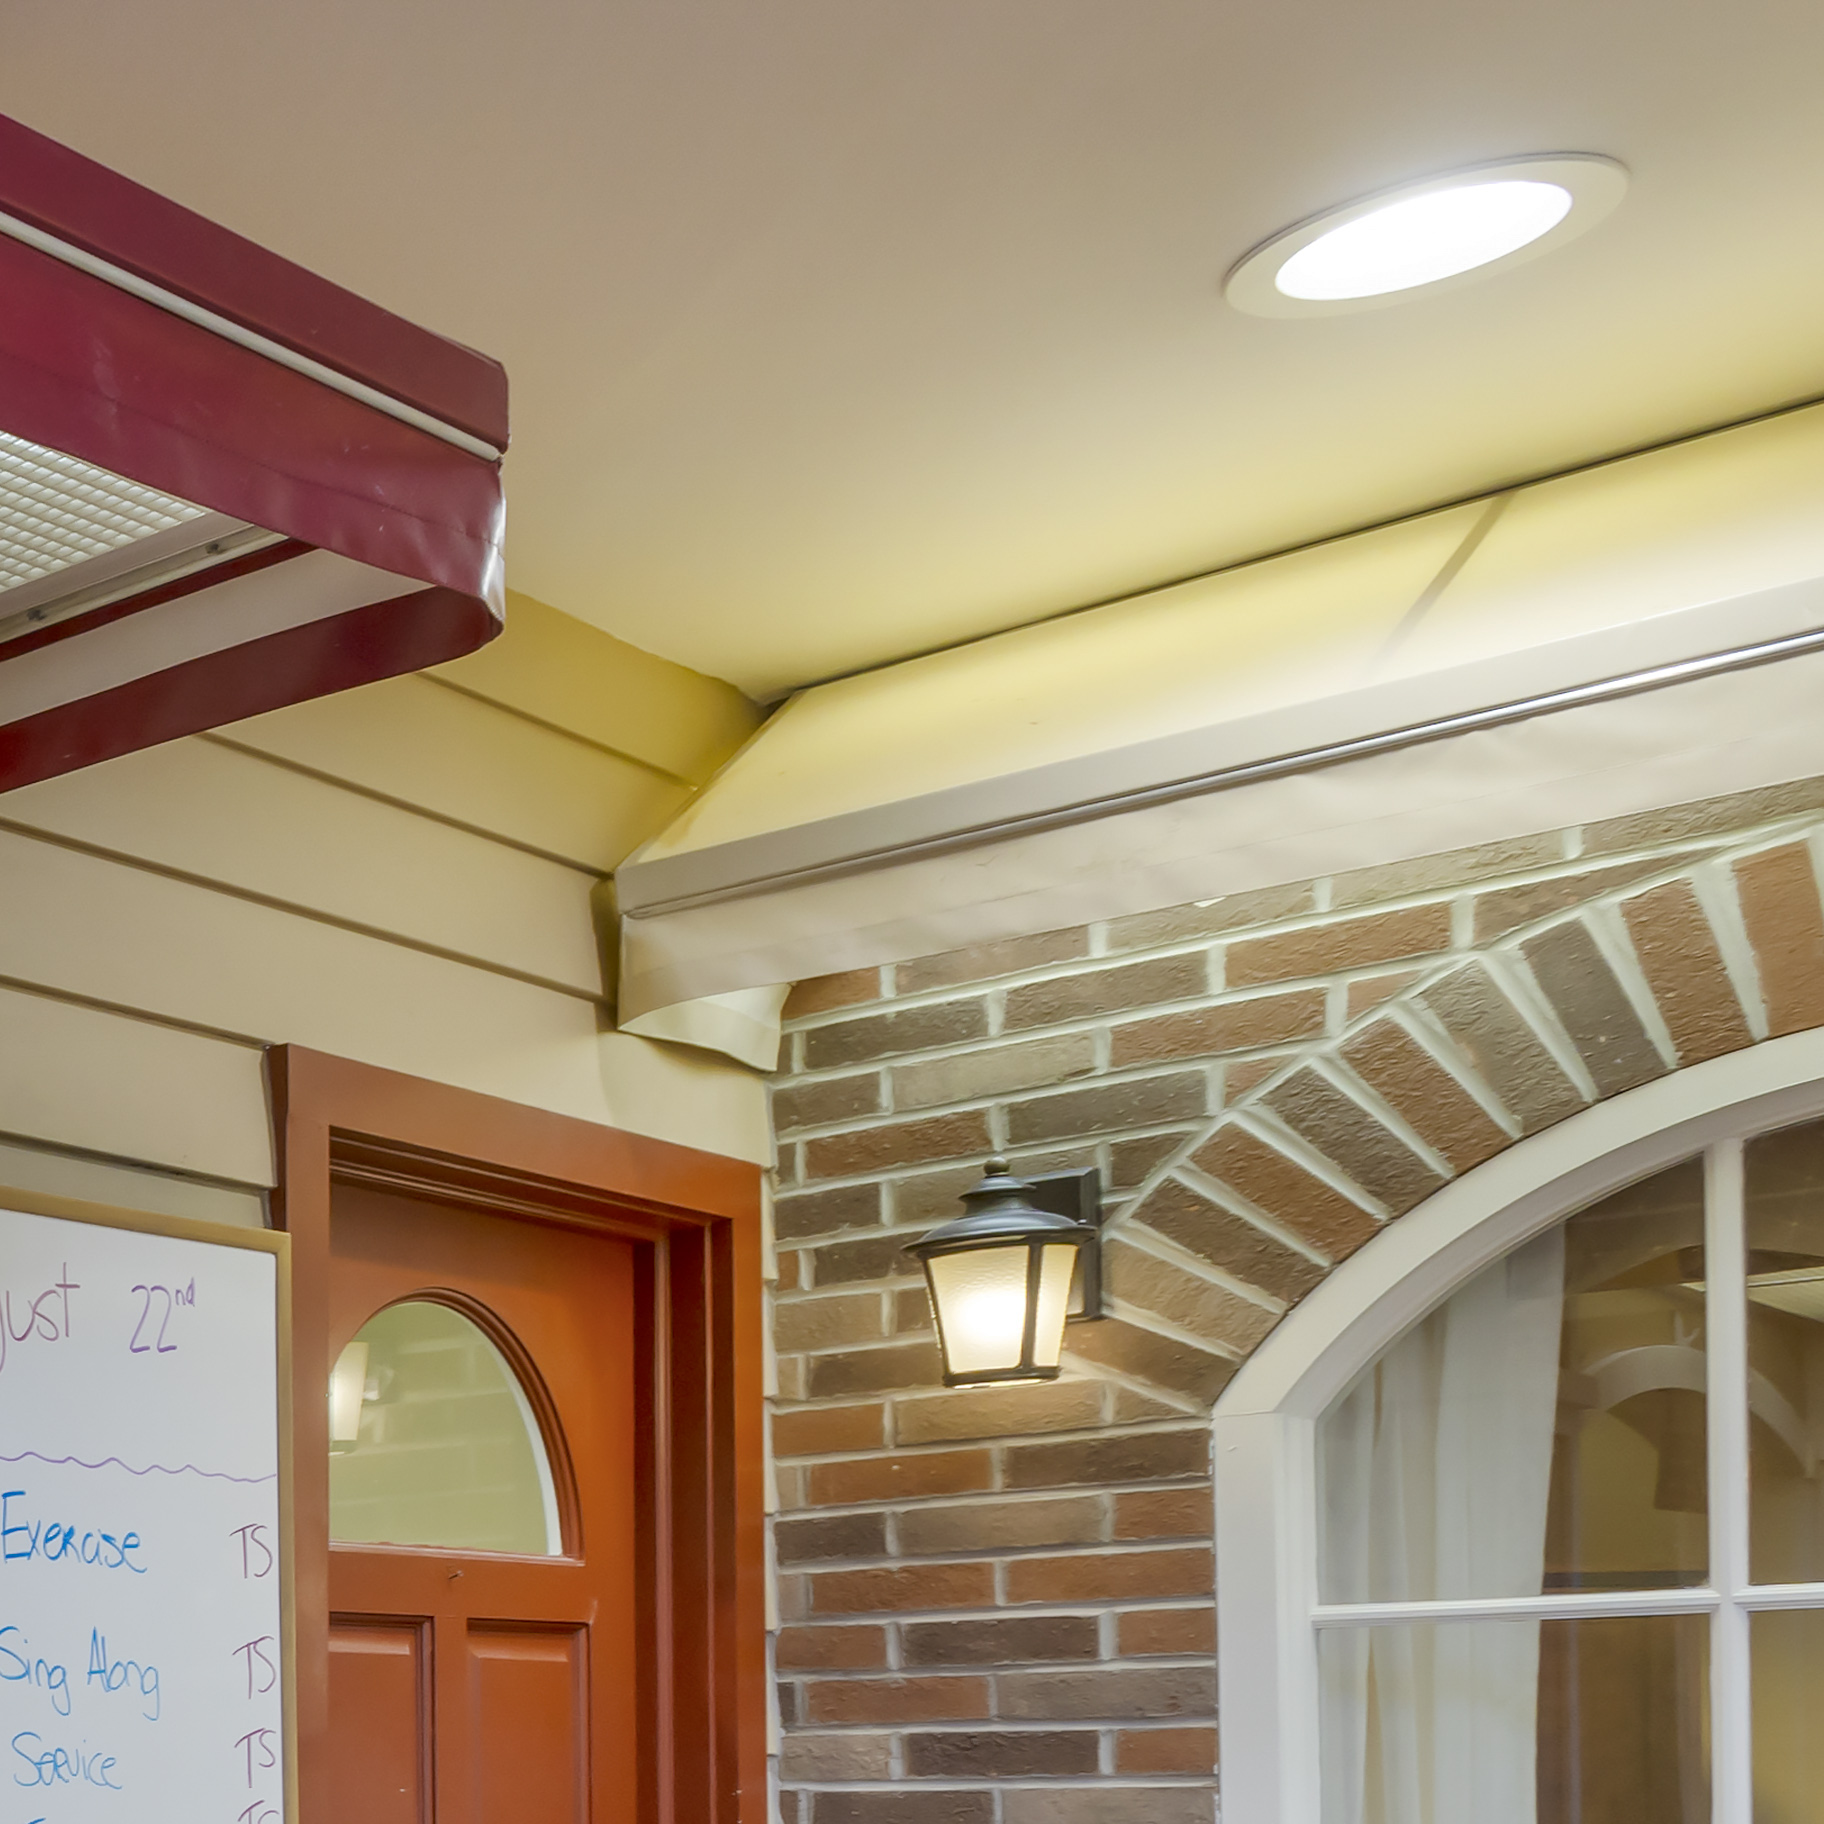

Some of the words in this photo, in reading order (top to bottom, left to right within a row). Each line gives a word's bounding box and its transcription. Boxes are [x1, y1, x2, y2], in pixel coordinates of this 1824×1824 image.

[130, 1277, 196, 1353] 22nd
[1, 1491, 147, 1573] Exercise
[229, 1524, 273, 1578] TS
[87, 1627, 160, 1721] Along
[233, 1635, 276, 1699] TS
[12, 1732, 122, 1789] Service
[234, 1728, 276, 1788] TS
